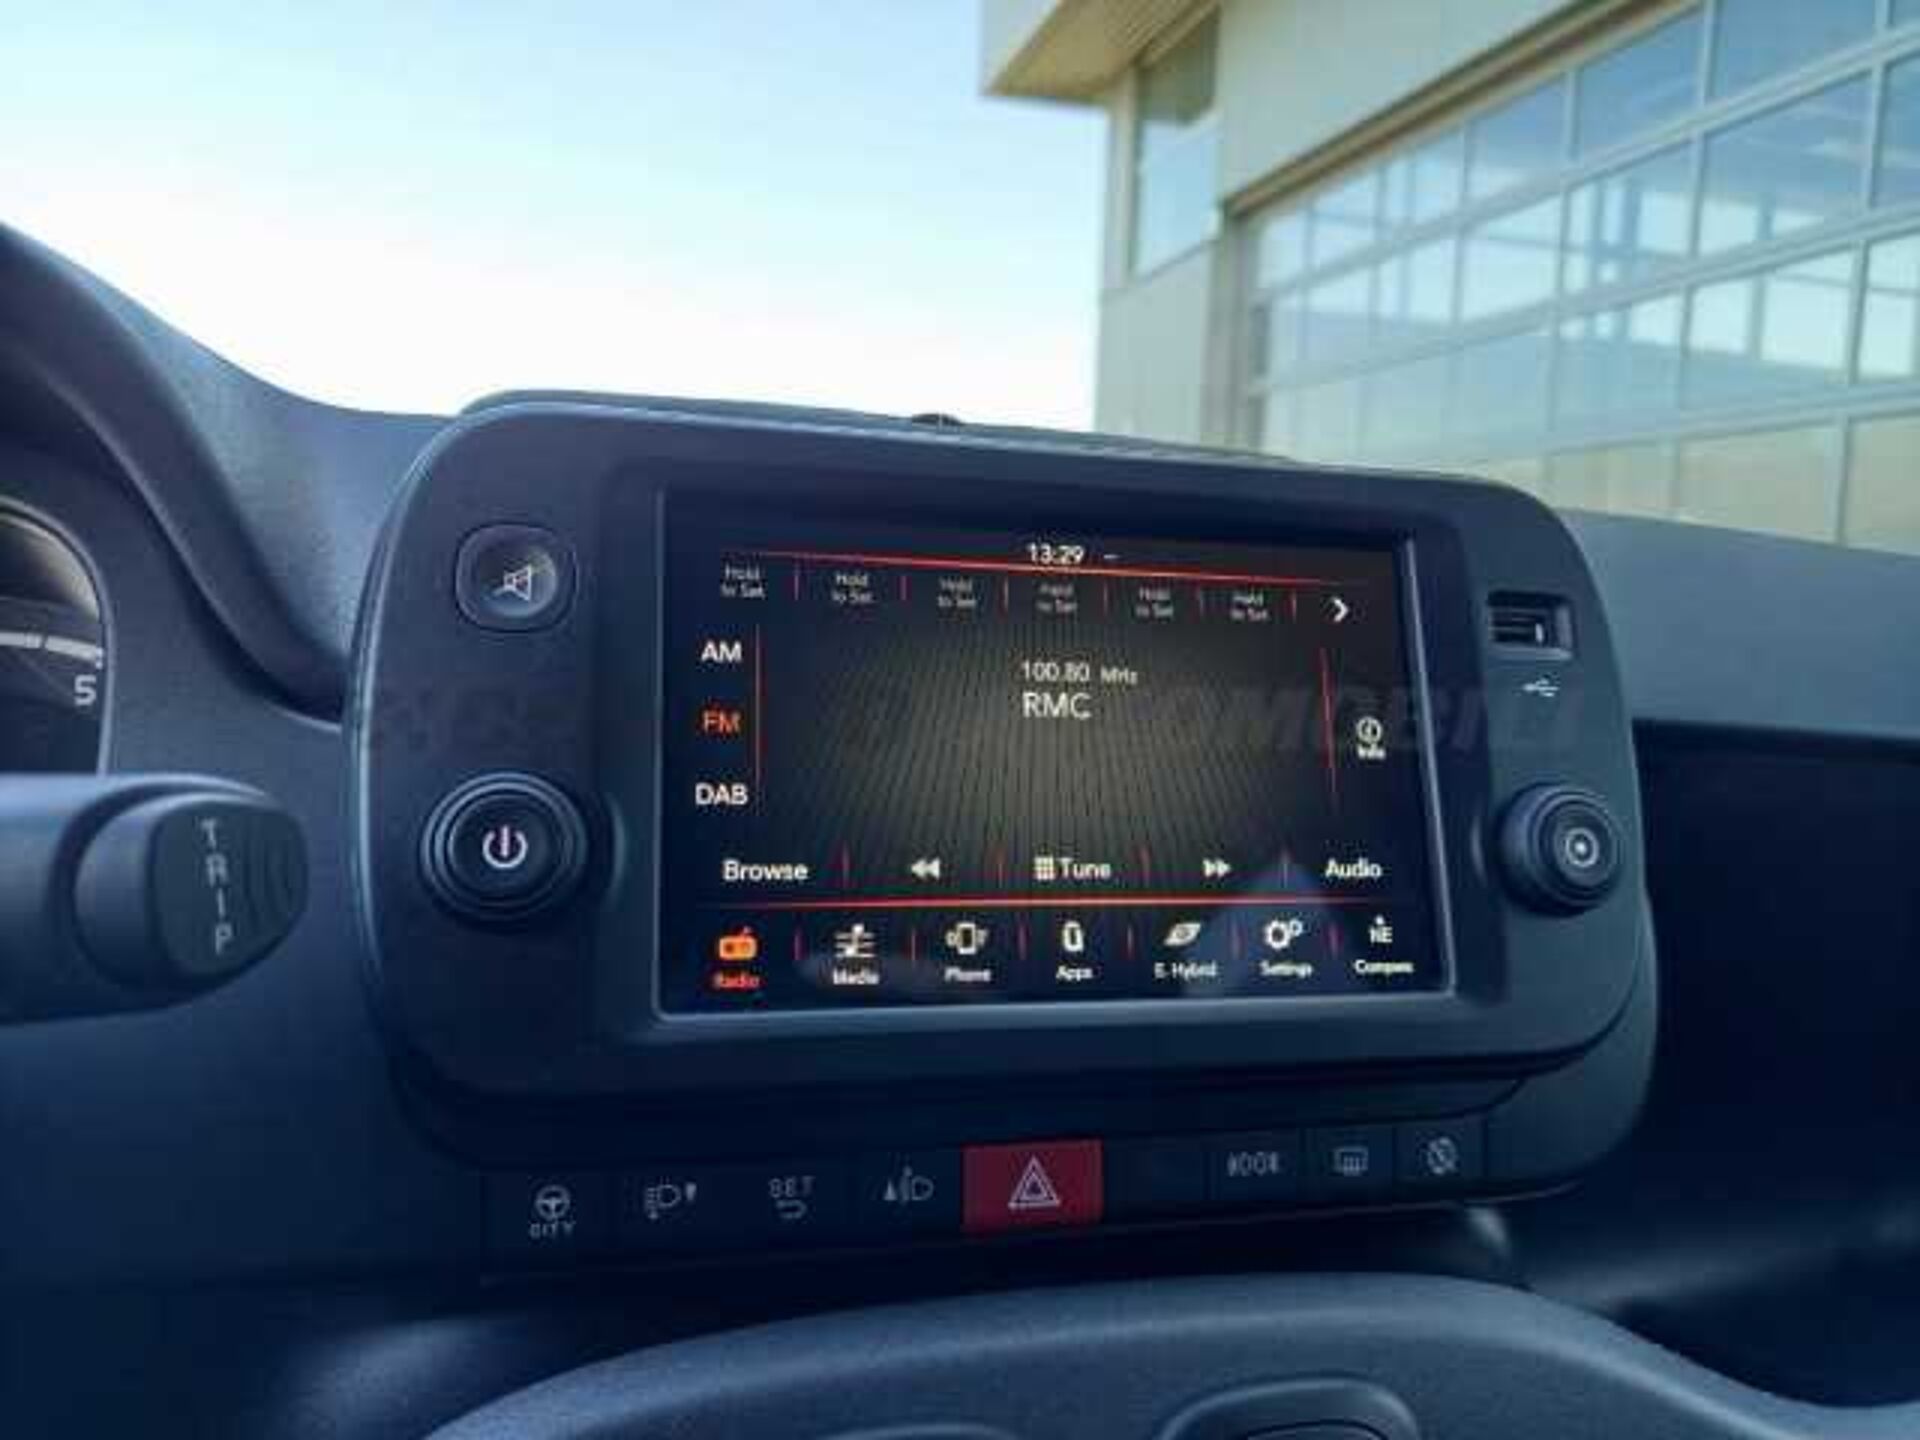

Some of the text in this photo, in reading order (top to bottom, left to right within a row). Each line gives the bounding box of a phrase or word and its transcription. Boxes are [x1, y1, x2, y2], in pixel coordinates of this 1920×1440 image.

[1027, 541, 1085, 565] 13:29
[700, 640, 743, 663] AM
[1021, 660, 1091, 684] 100.80
[1021, 691, 1092, 719] RMC
[702, 710, 742, 735] FM
[694, 782, 749, 807] DAB
[722, 858, 810, 883] Browse
[1059, 860, 1112, 880] Tune
[1325, 858, 1384, 880] Audio
[199, 817, 236, 955] TRIP
[1055, 963, 1094, 982] Apps
